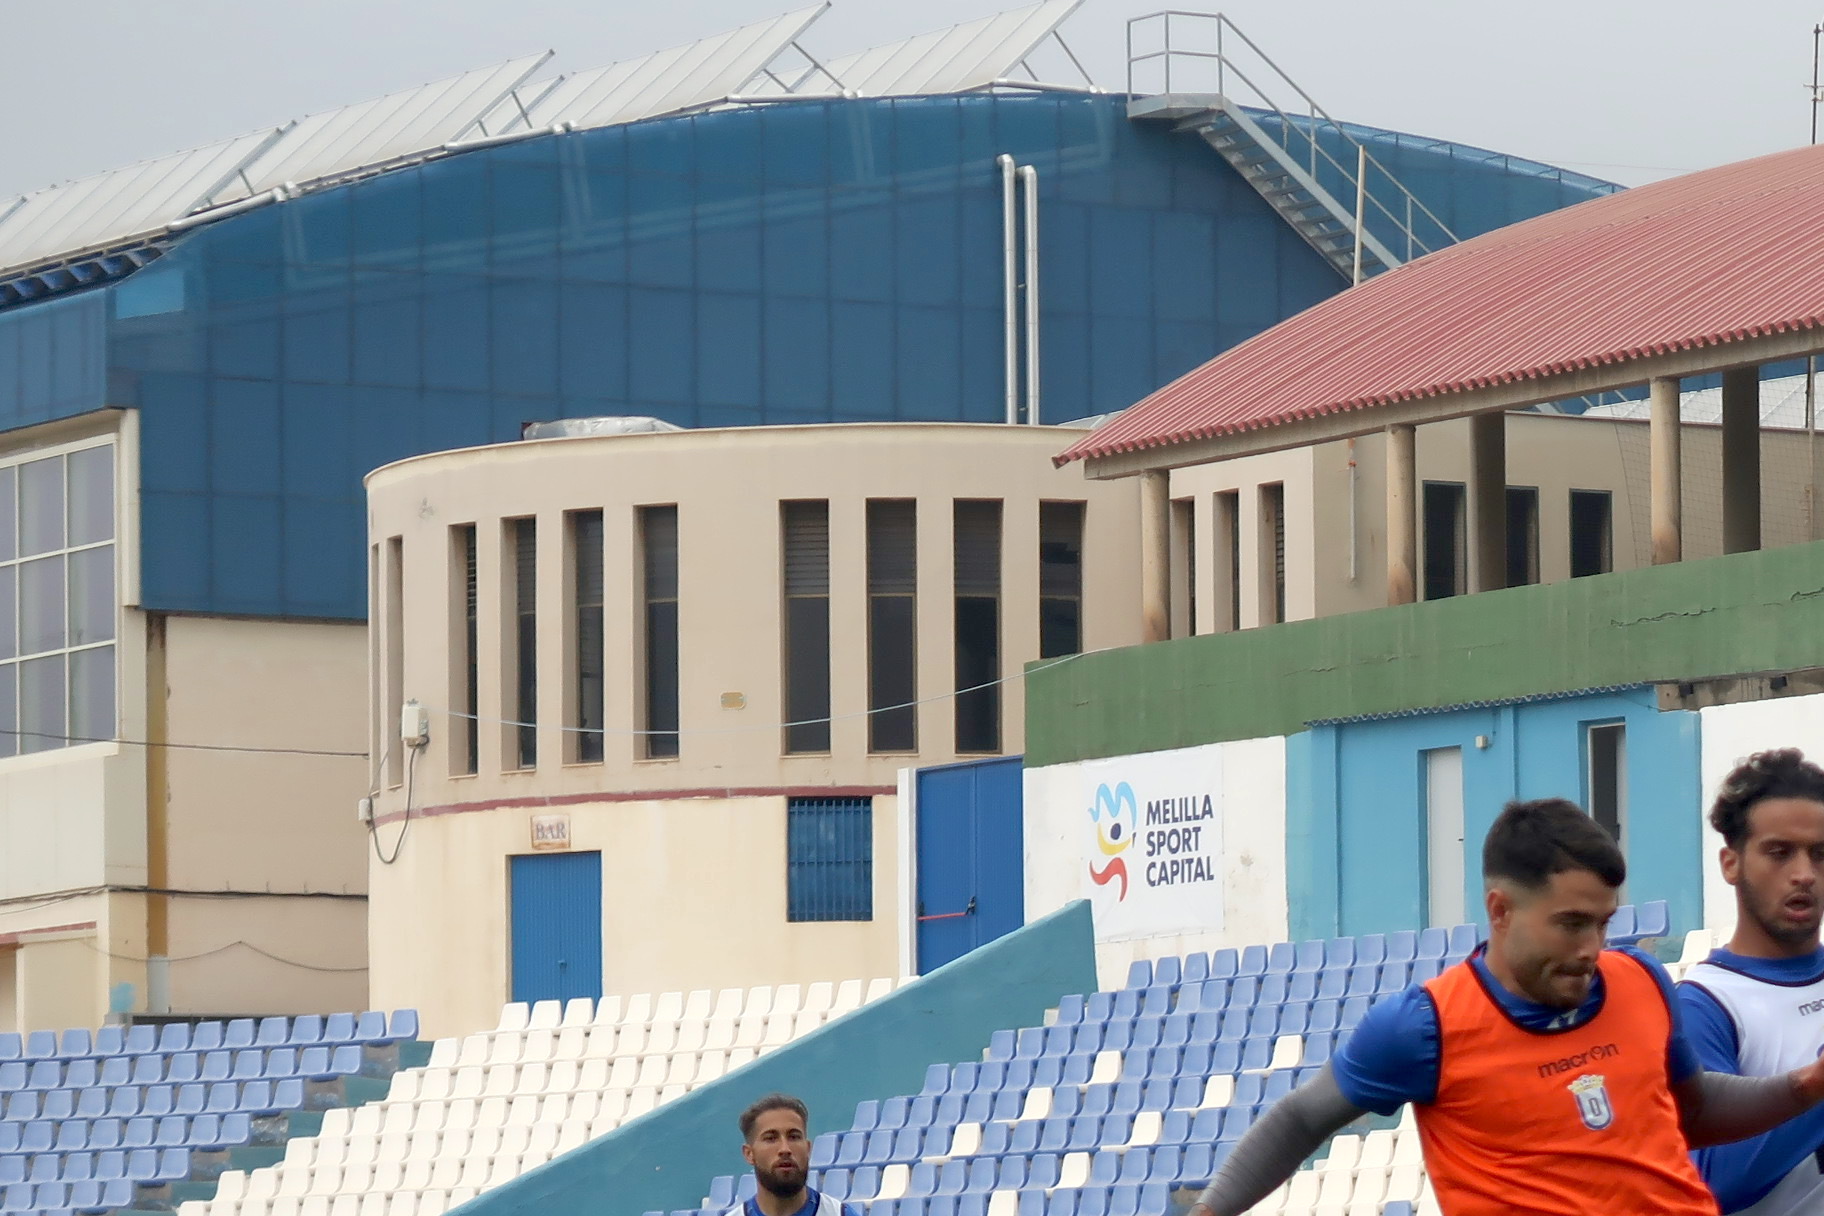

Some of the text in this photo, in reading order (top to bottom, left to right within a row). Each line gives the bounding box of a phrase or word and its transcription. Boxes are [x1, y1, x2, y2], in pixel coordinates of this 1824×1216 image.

[1146, 794, 1214, 827] MELILLA
[535, 822, 567, 840] BAR
[1146, 826, 1202, 857] SPORT
[1146, 855, 1215, 888] CAPITAL
[1537, 1043, 1620, 1078] macron
